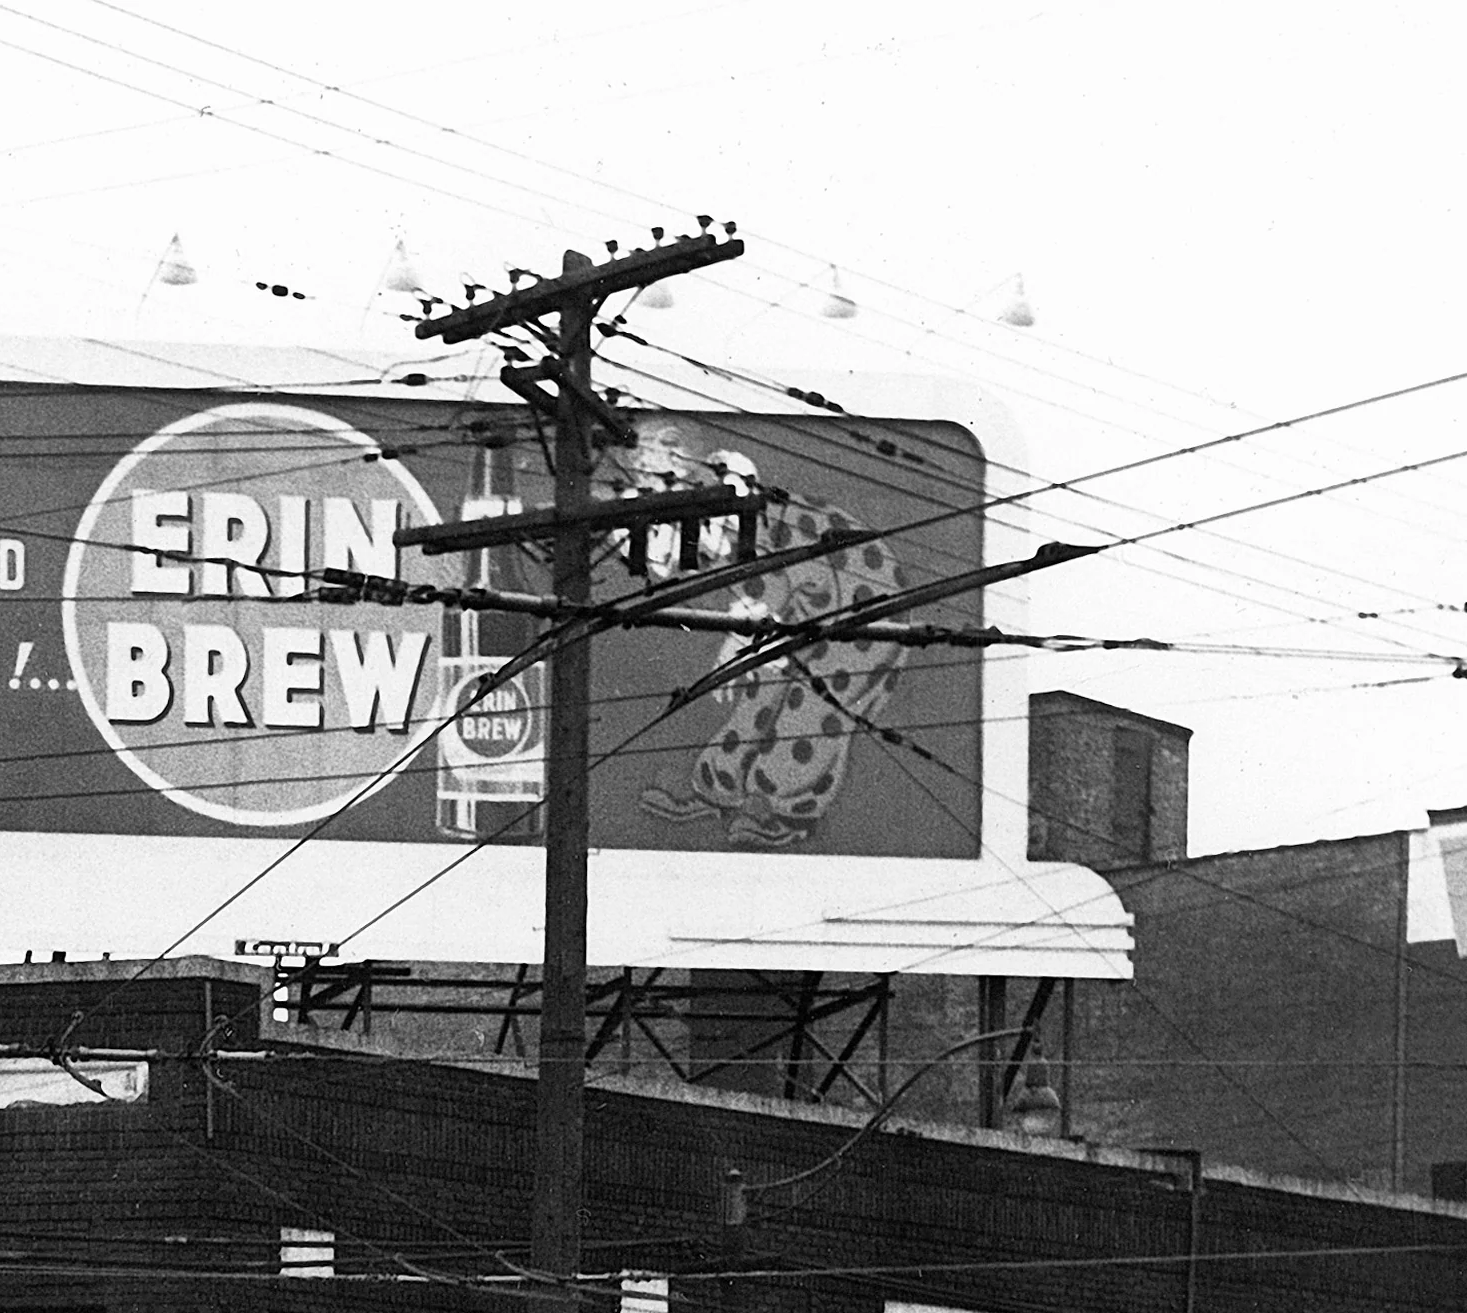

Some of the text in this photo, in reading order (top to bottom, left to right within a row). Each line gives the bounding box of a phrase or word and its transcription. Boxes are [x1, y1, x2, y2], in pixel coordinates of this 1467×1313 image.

[127, 487, 412, 602] ERIN
[105, 622, 433, 732] BREW
[462, 717, 523, 741] BREW
